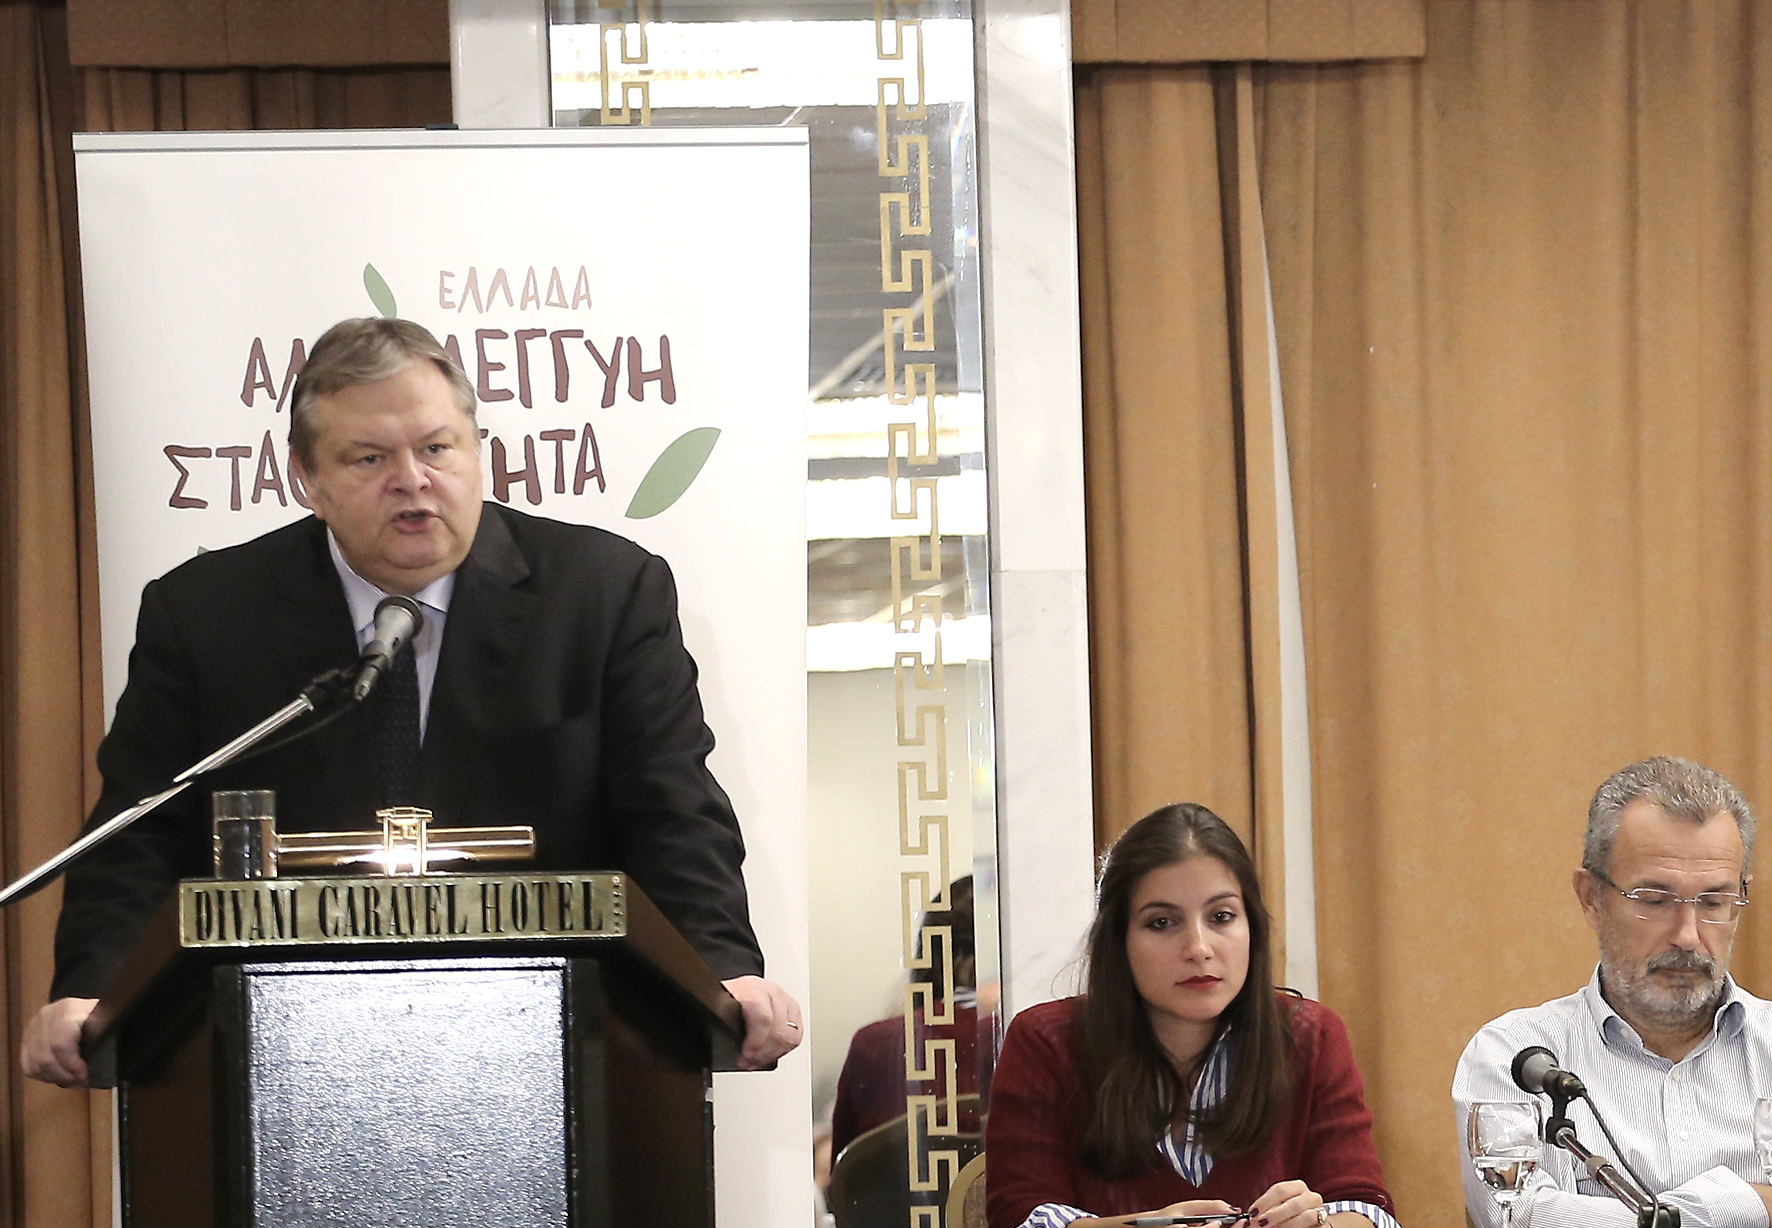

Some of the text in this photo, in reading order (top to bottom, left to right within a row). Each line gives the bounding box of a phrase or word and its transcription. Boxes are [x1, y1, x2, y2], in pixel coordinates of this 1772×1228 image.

[438, 264, 593, 314] ΕΛΛΑΔΑ
[195, 879, 604, 941] DIVANI CARAVEL HOTEL
